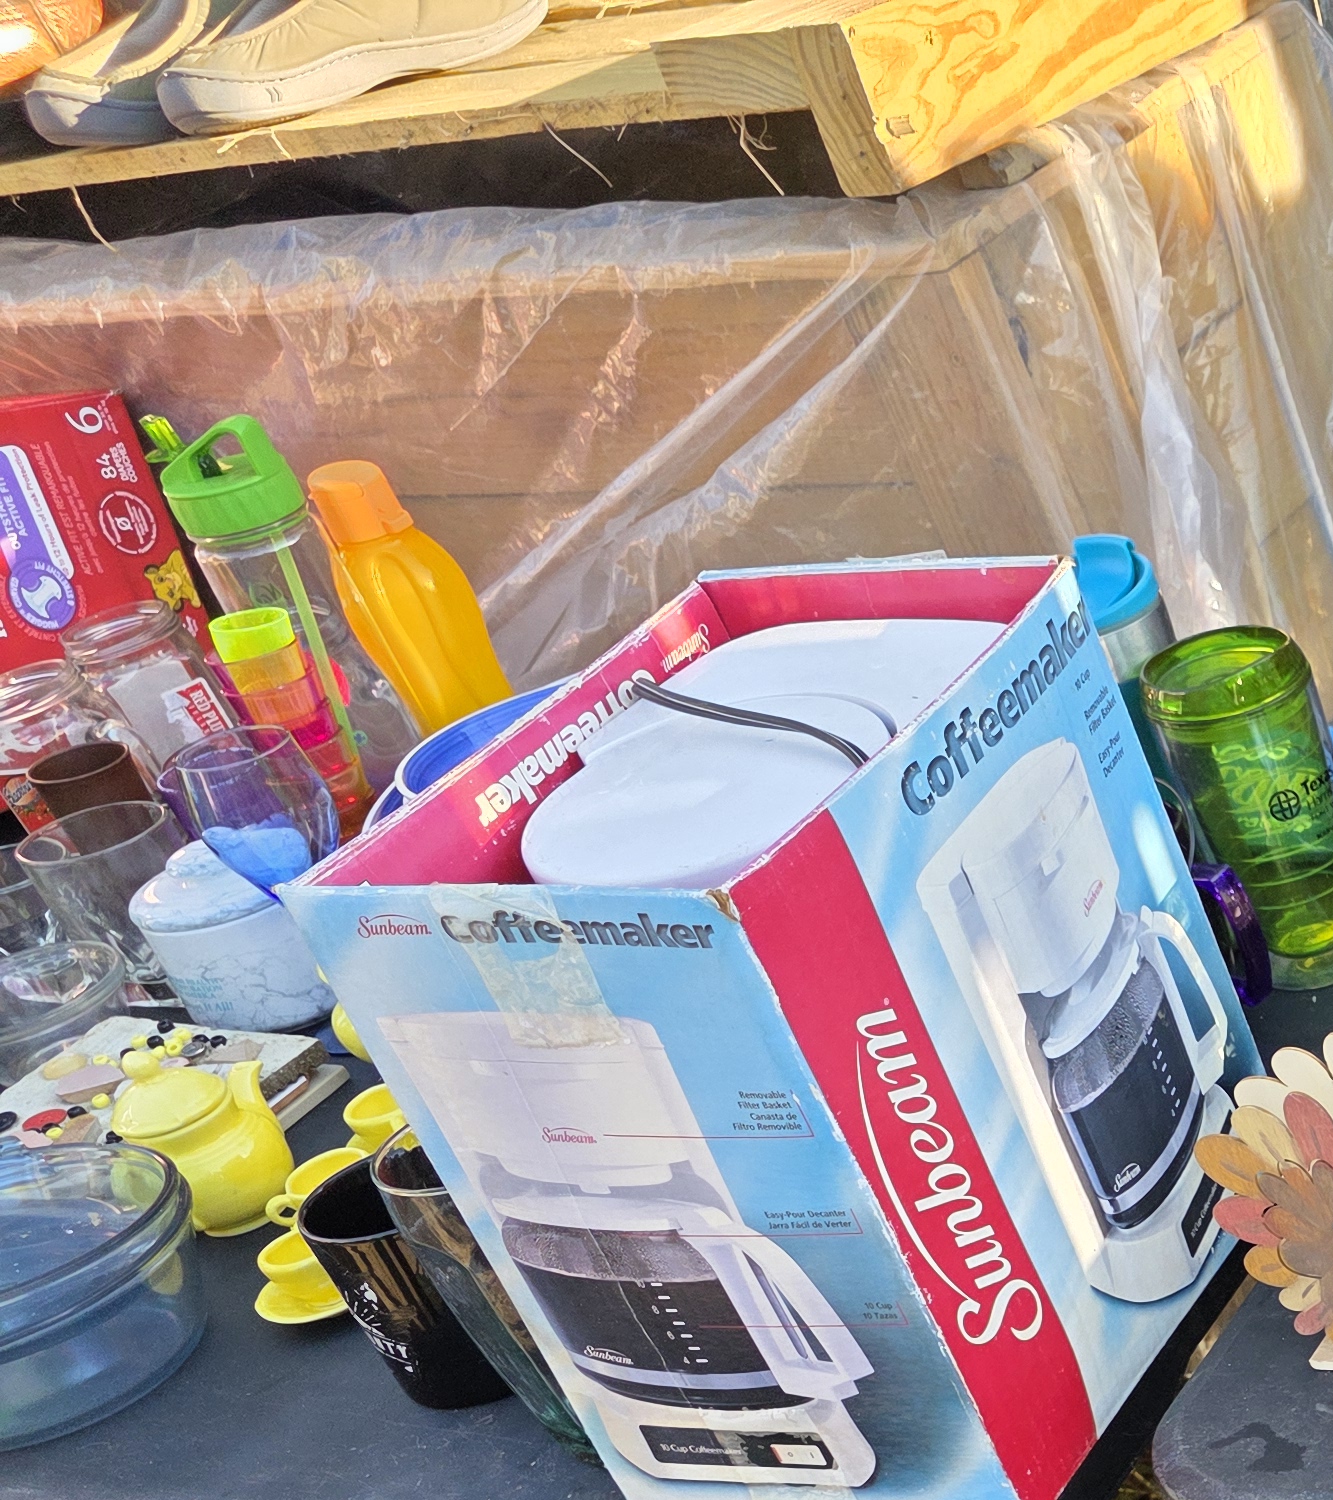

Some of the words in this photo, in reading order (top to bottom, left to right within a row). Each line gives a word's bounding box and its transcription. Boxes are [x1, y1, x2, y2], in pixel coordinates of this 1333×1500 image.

[65, 406, 103, 434] 6
[96, 453, 117, 479] 84
[190, 689, 211, 712] RED
[202, 710, 226, 732] PLU
[901, 596, 1091, 816] Coffeemaker
[357, 914, 432, 939] Sunbeam
[441, 909, 715, 949] Coffeemaker
[738, 1091, 787, 1100] Removable
[737, 1100, 761, 1110] Filter
[763, 1100, 792, 1110] Basket
[750, 1112, 784, 1121] Canasta
[786, 1112, 797, 1121] de
[733, 1122, 756, 1131] Filtro
[757, 1122, 803, 1131] Removible
[541, 1126, 598, 1144] Sunbeam
[855, 1006, 1044, 1346] Sunbeam
[764, 1210, 806, 1221] Easy-Pour
[807, 1210, 847, 1219] Decanter
[768, 1221, 790, 1230] Jarra
[811, 1220, 823, 1229] de
[824, 1219, 852, 1229] Verter
[864, 1302, 874, 1311] 10
[876, 1302, 893, 1312] Cup
[863, 1312, 873, 1320] 10
[874, 1312, 899, 1321] Tazas
[584, 1345, 635, 1366] Sunbeam
[670, 1444, 688, 1454] Cup
